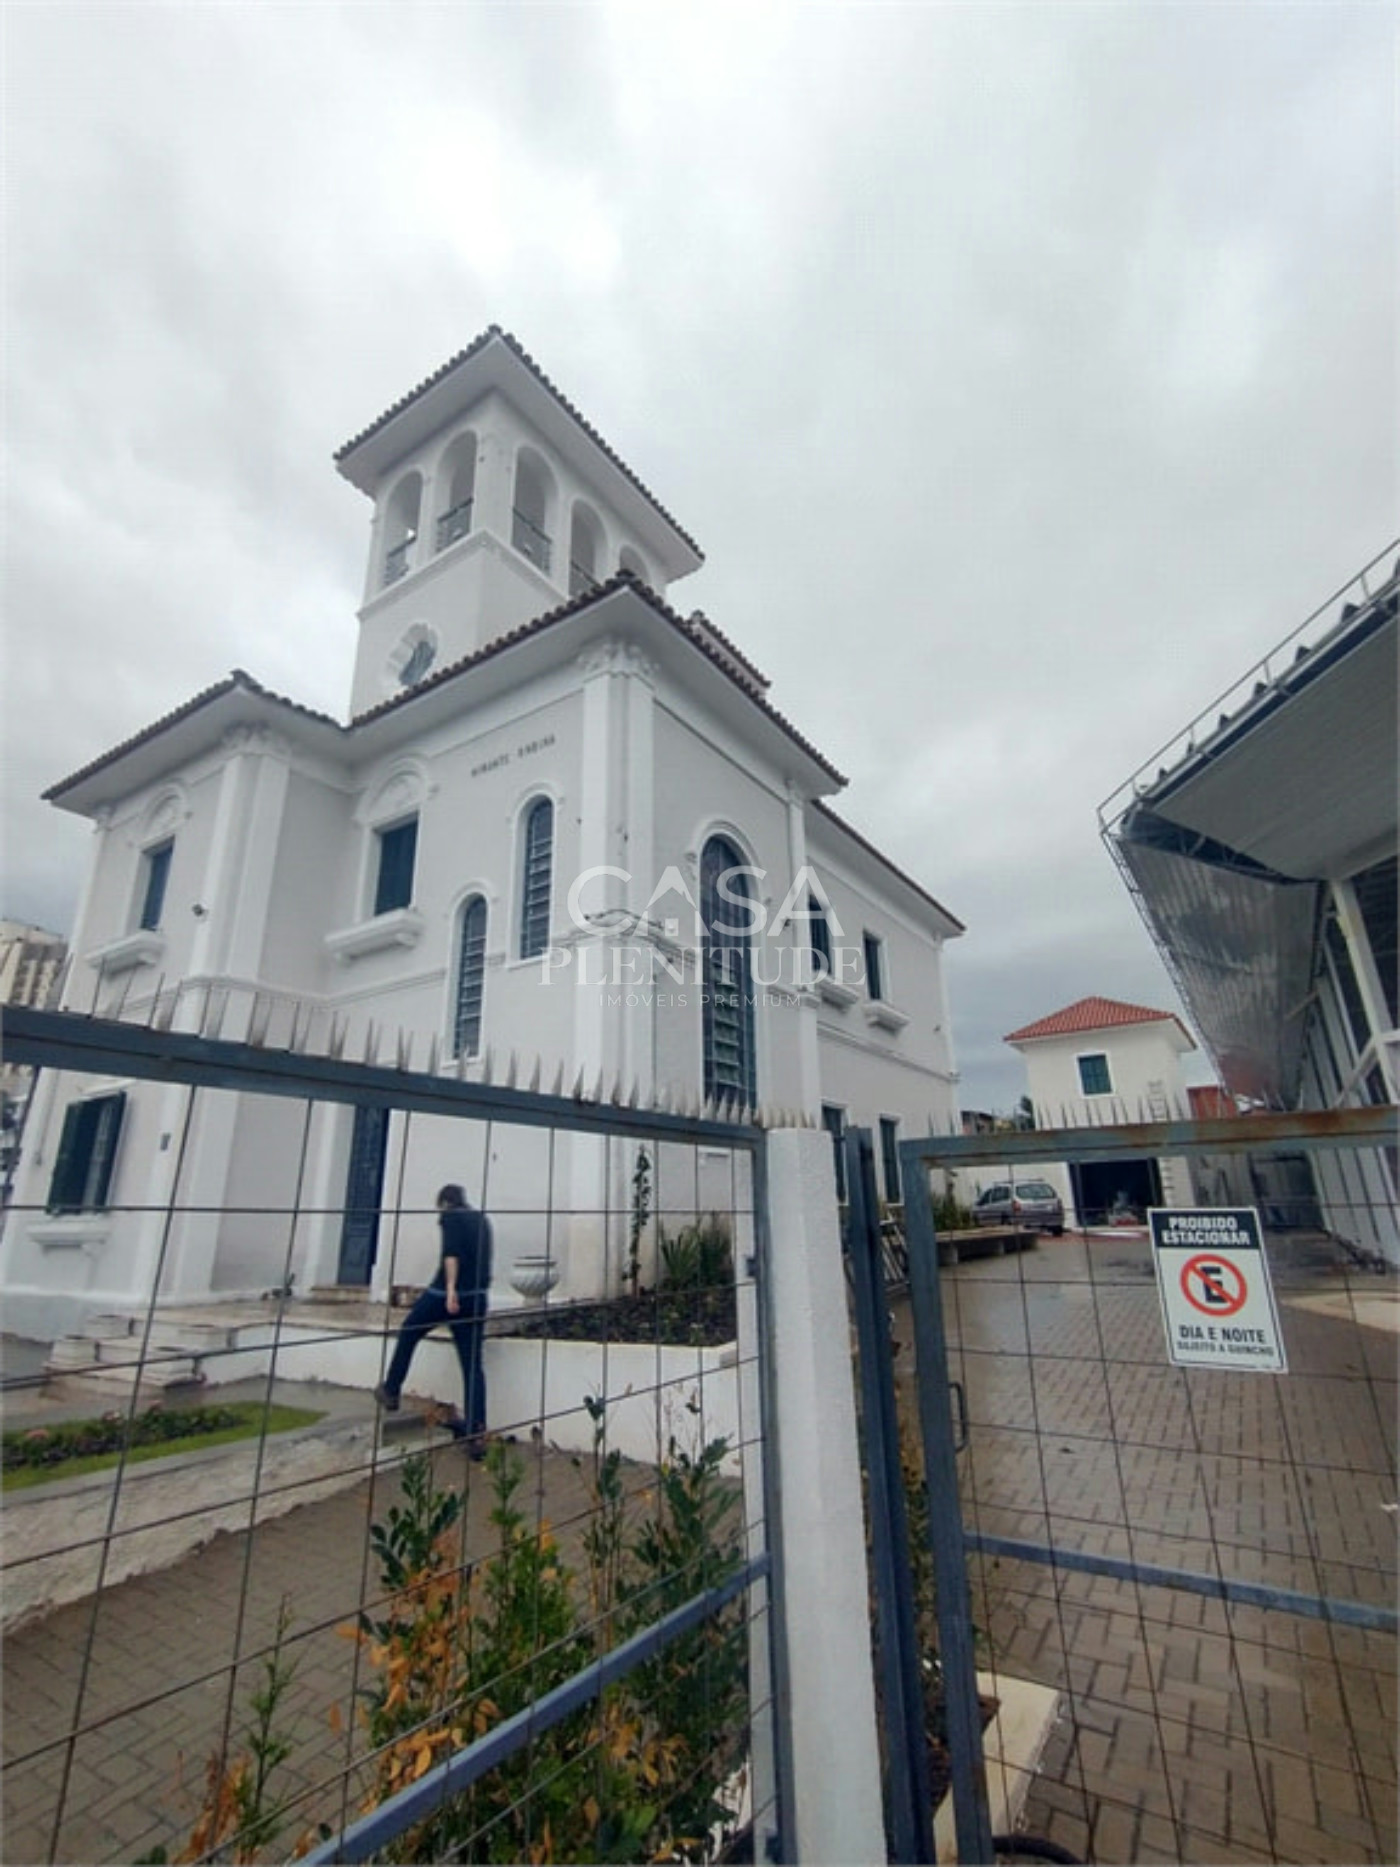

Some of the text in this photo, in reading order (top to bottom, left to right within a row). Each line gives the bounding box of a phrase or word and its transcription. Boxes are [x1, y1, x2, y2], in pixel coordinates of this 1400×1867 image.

[1168, 1216, 1238, 1231] PROIBIDO
[1161, 1230, 1251, 1246] ESTACIONAR
[1179, 1324, 1265, 1344] DIA E NOITE
[1176, 1341, 1216, 1353] SUJEITO
[1229, 1344, 1275, 1357] GUINCHO
